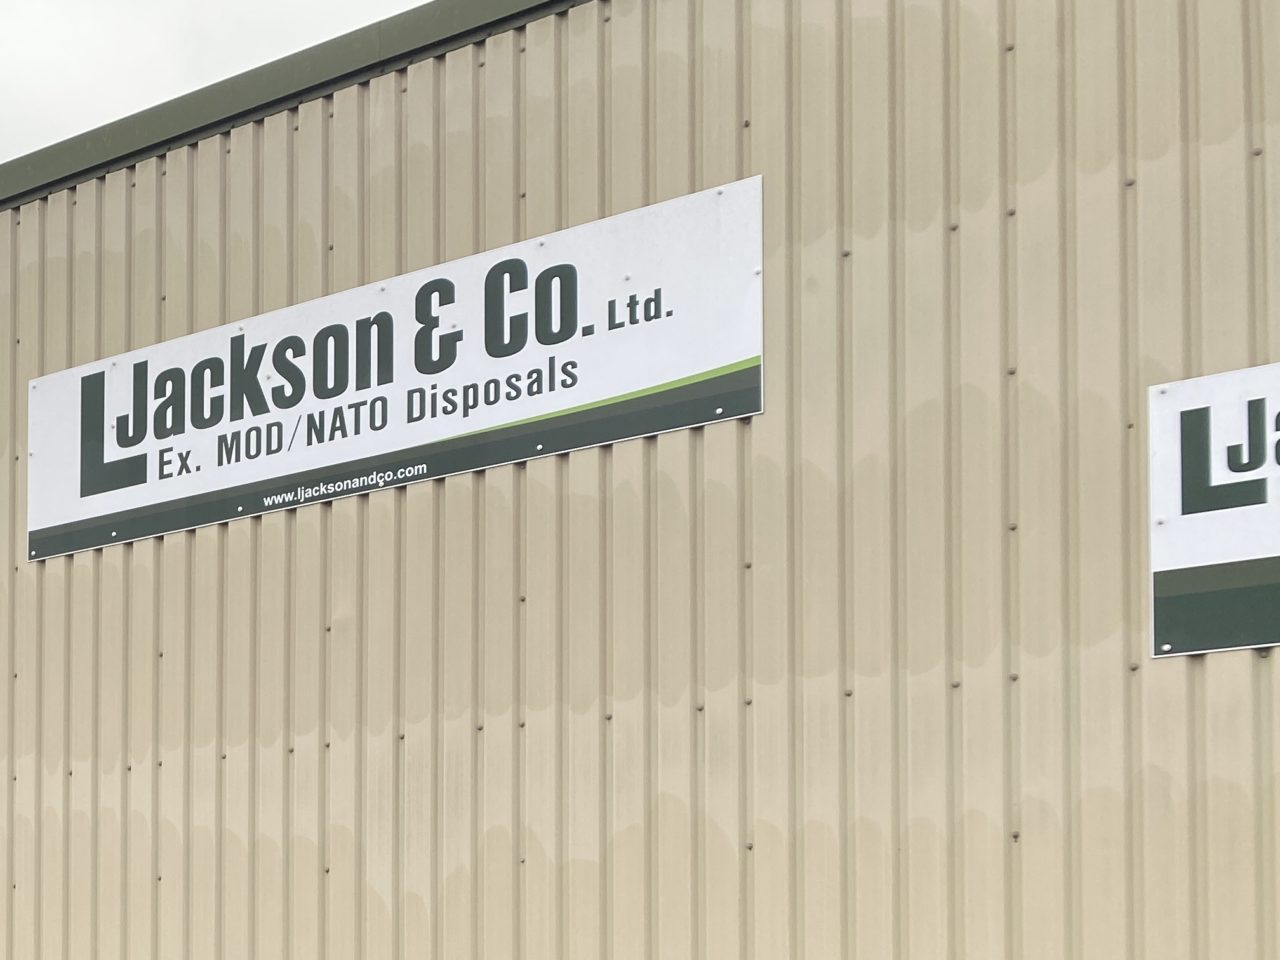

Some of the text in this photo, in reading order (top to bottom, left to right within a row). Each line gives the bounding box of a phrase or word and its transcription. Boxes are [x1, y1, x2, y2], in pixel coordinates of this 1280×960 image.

[414, 278, 464, 375] &
[484, 258, 595, 358] Co.
[607, 287, 674, 331] Ltd.
[158, 355, 579, 480] Ex. MOD/NATO Disposals
[263, 463, 428, 507] www.ljacksonandco.com
